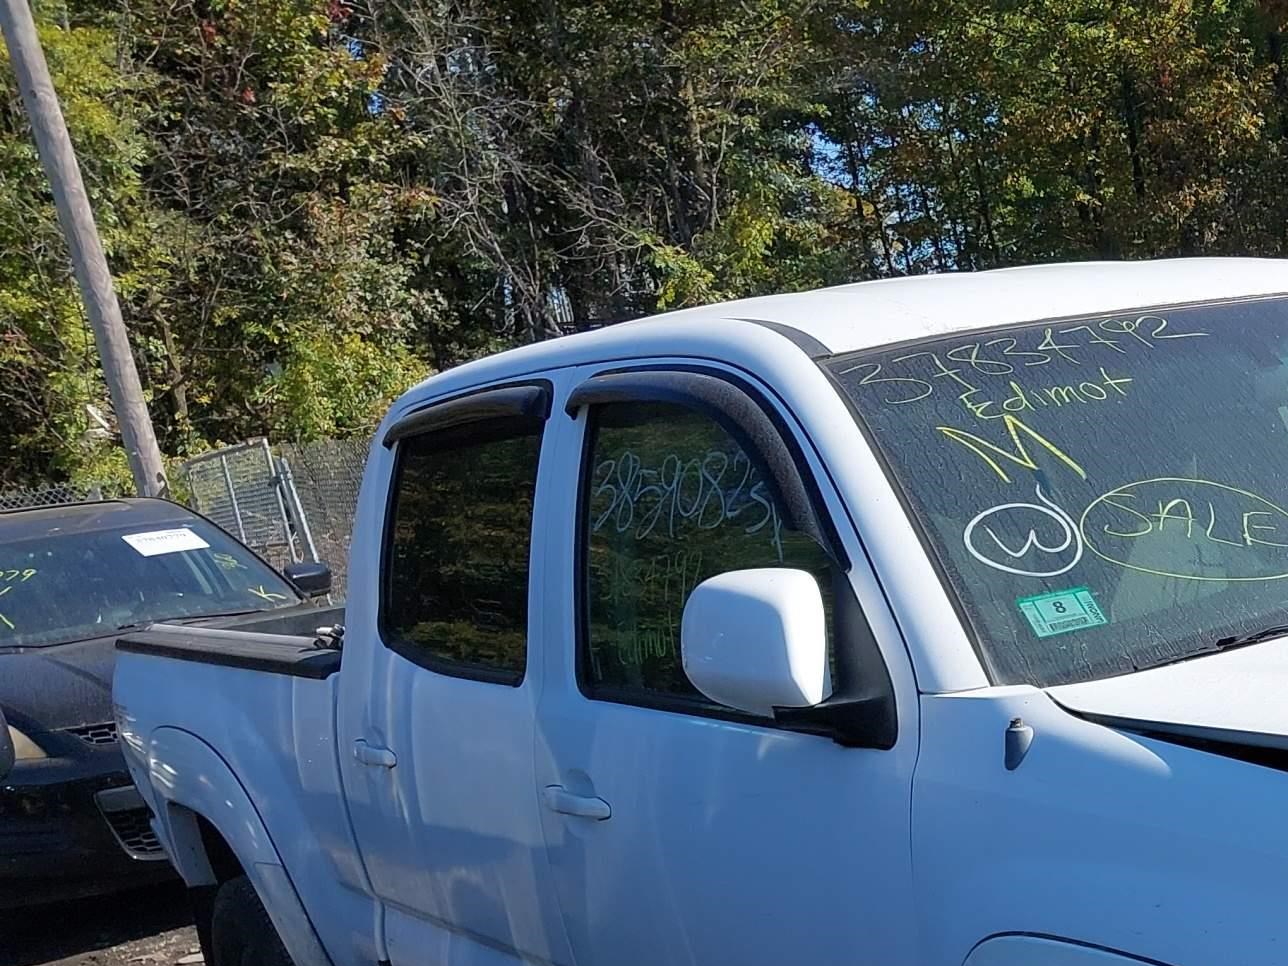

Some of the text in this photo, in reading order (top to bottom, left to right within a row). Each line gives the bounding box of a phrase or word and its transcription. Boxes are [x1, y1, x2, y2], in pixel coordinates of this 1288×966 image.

[839, 316, 1209, 403] 37834792
[935, 414, 1087, 483] M
[1100, 493, 1288, 549] SALE
[1052, 601, 1067, 614] 8
